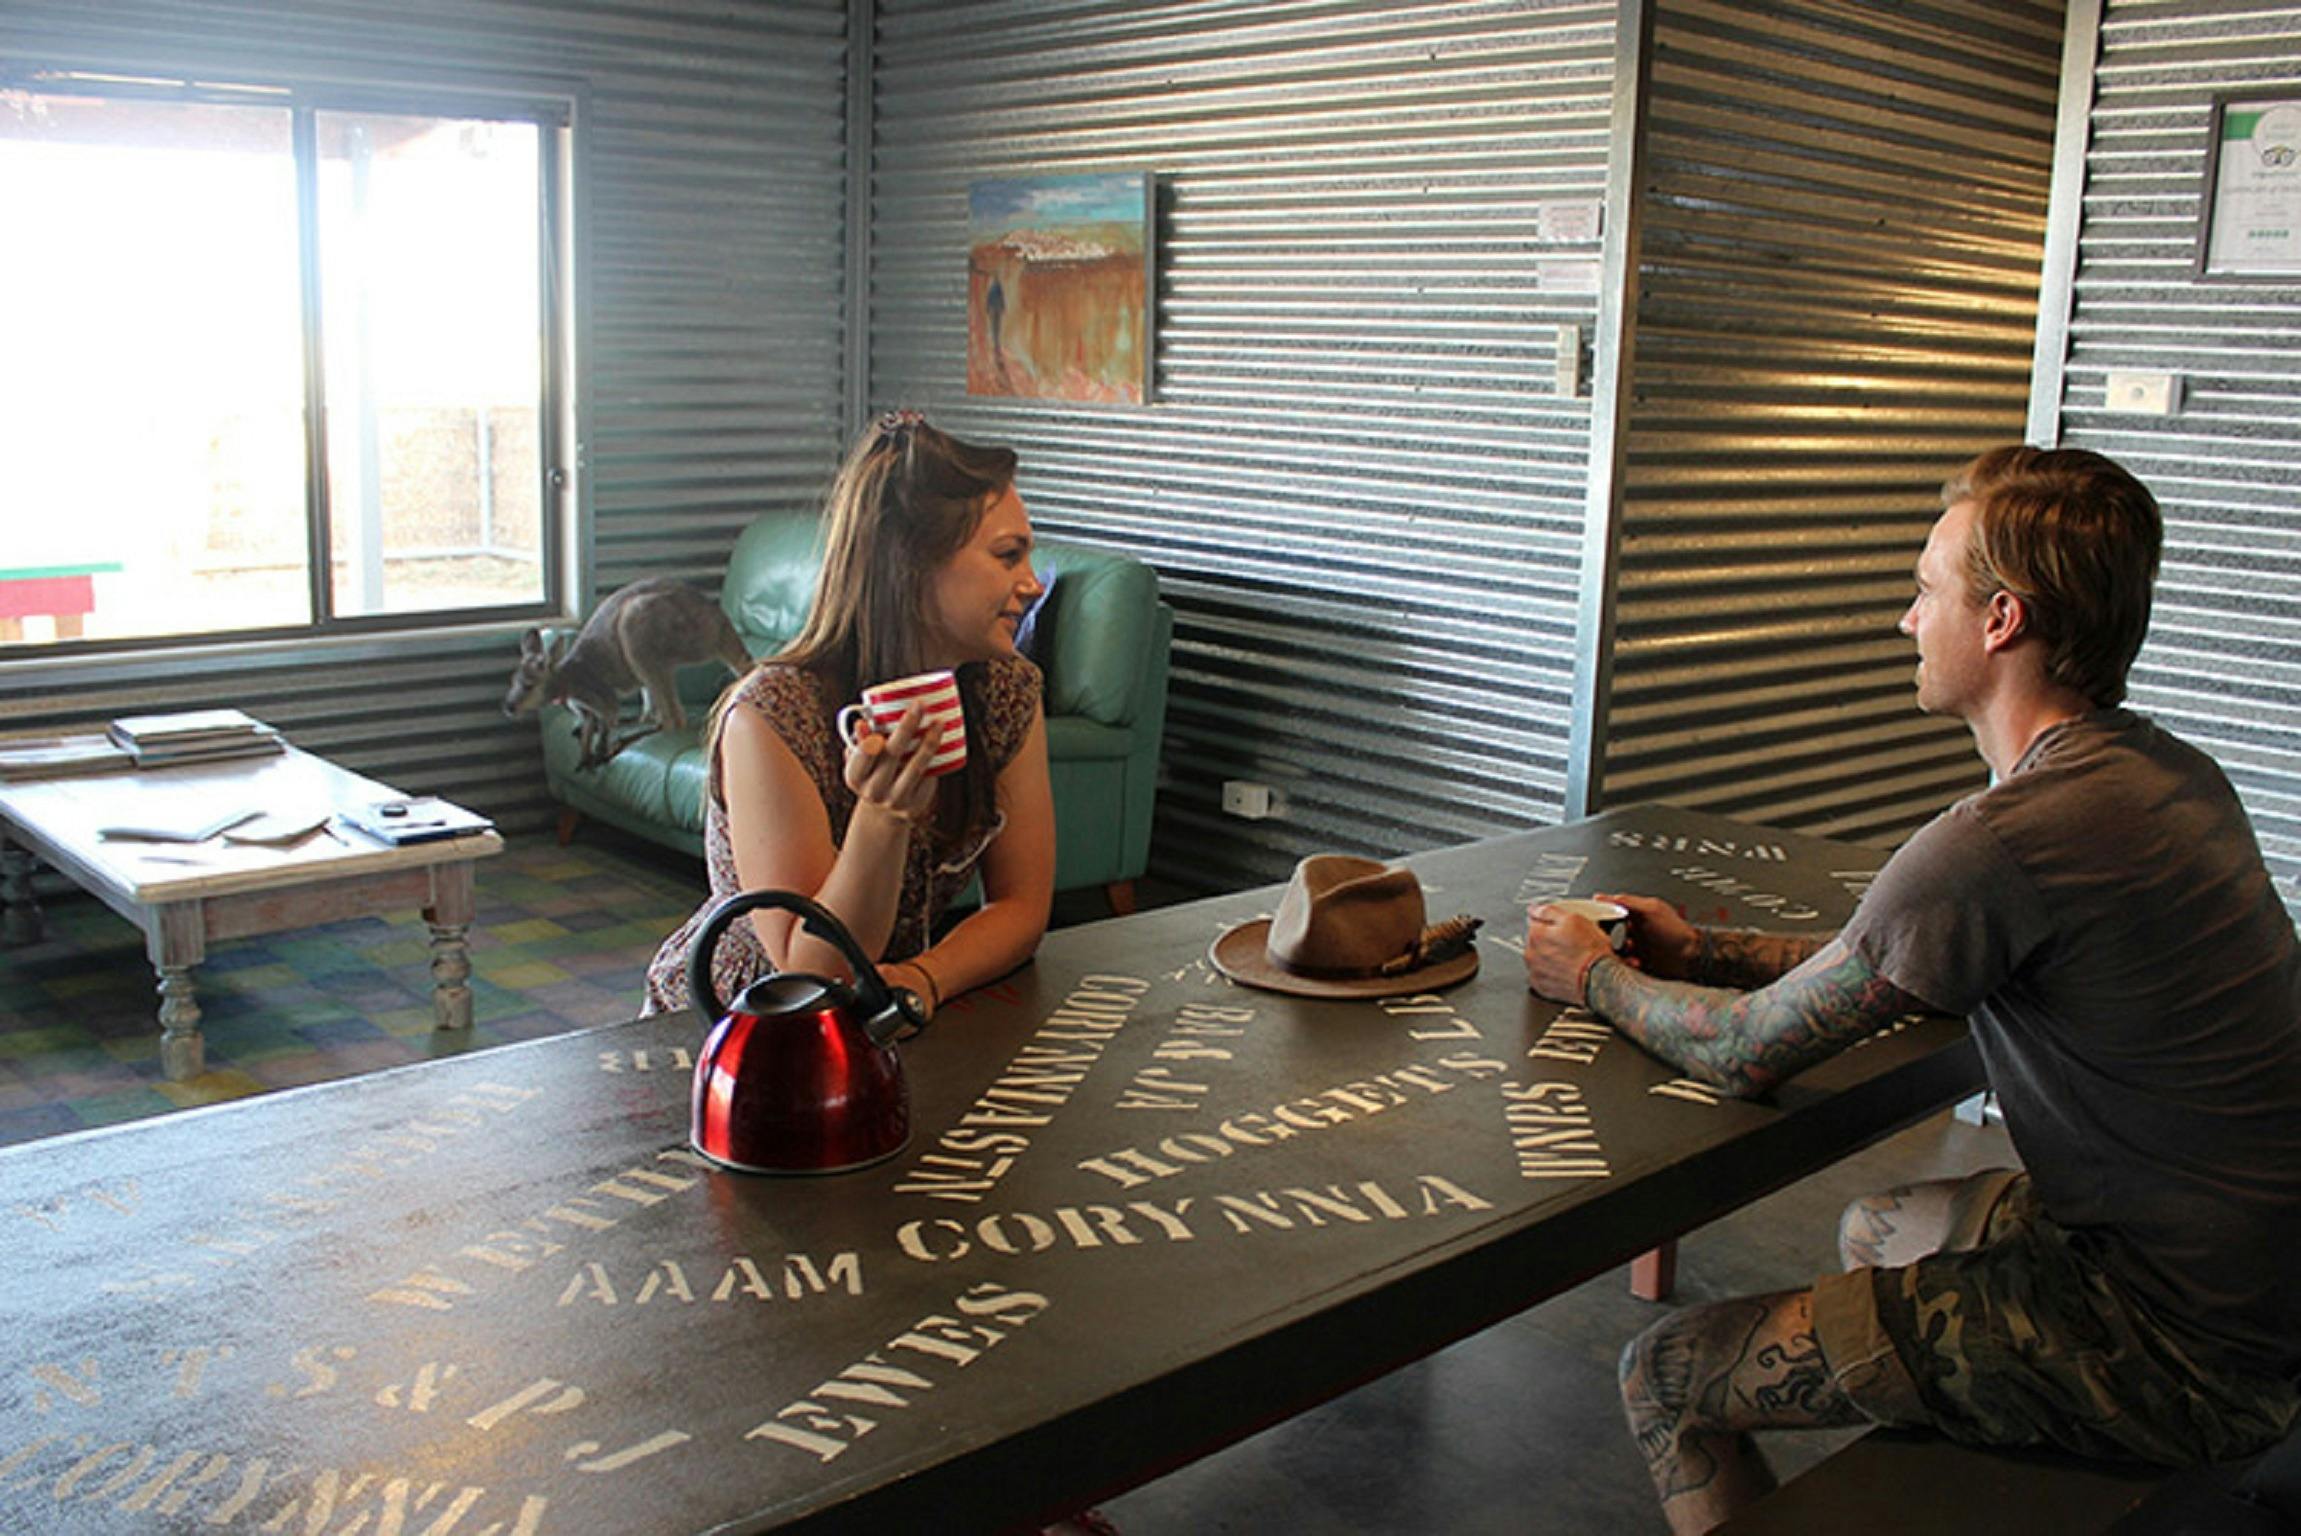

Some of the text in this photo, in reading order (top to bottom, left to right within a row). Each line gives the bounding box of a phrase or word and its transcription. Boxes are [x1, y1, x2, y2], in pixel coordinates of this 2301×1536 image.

[1077, 1051, 1507, 1189] HOGGETS
[556, 1252, 864, 1307] AAAM
[744, 1281, 1050, 1464] EWES
